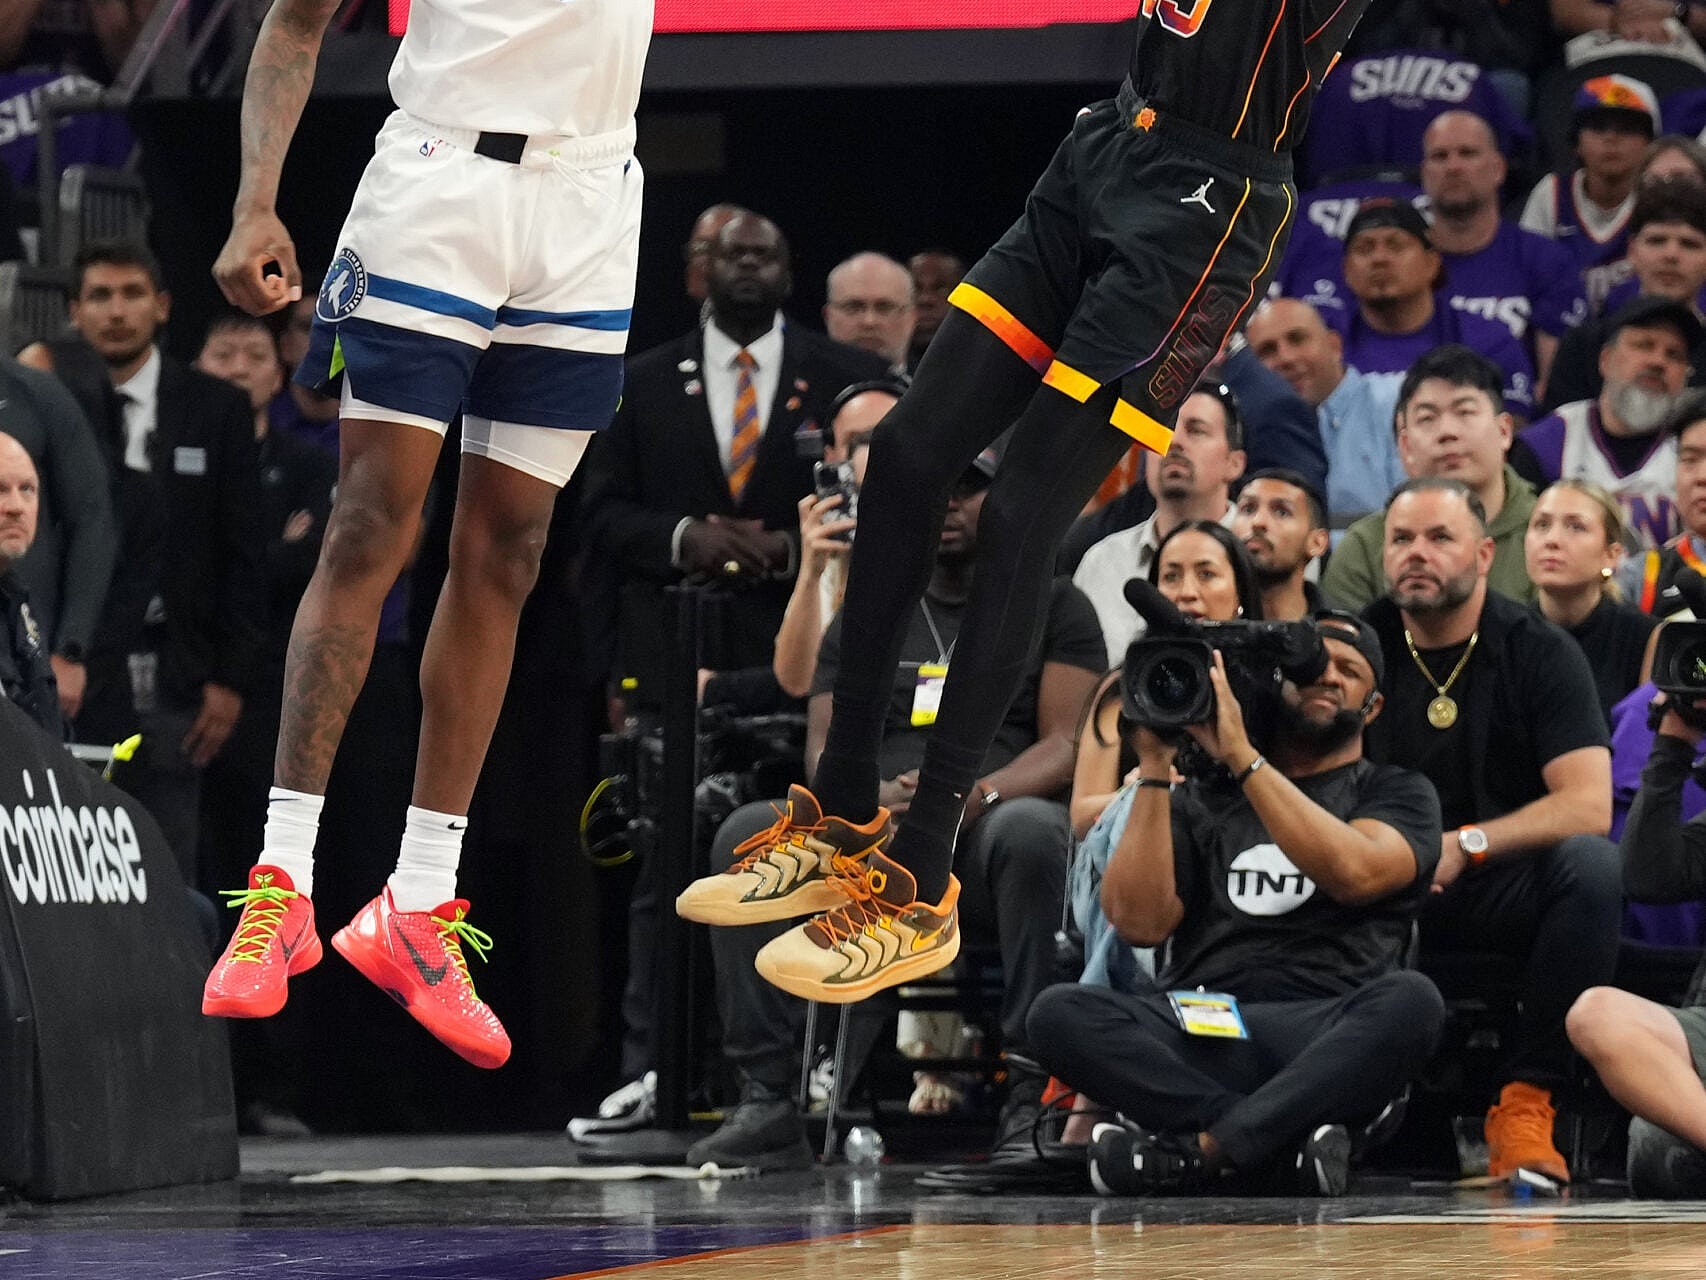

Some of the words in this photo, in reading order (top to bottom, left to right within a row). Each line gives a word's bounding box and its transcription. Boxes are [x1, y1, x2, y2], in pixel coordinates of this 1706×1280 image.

[1349, 55, 1482, 105] SUNS
[0, 768, 148, 905] coinbase
[1228, 869, 1306, 897] TNT
